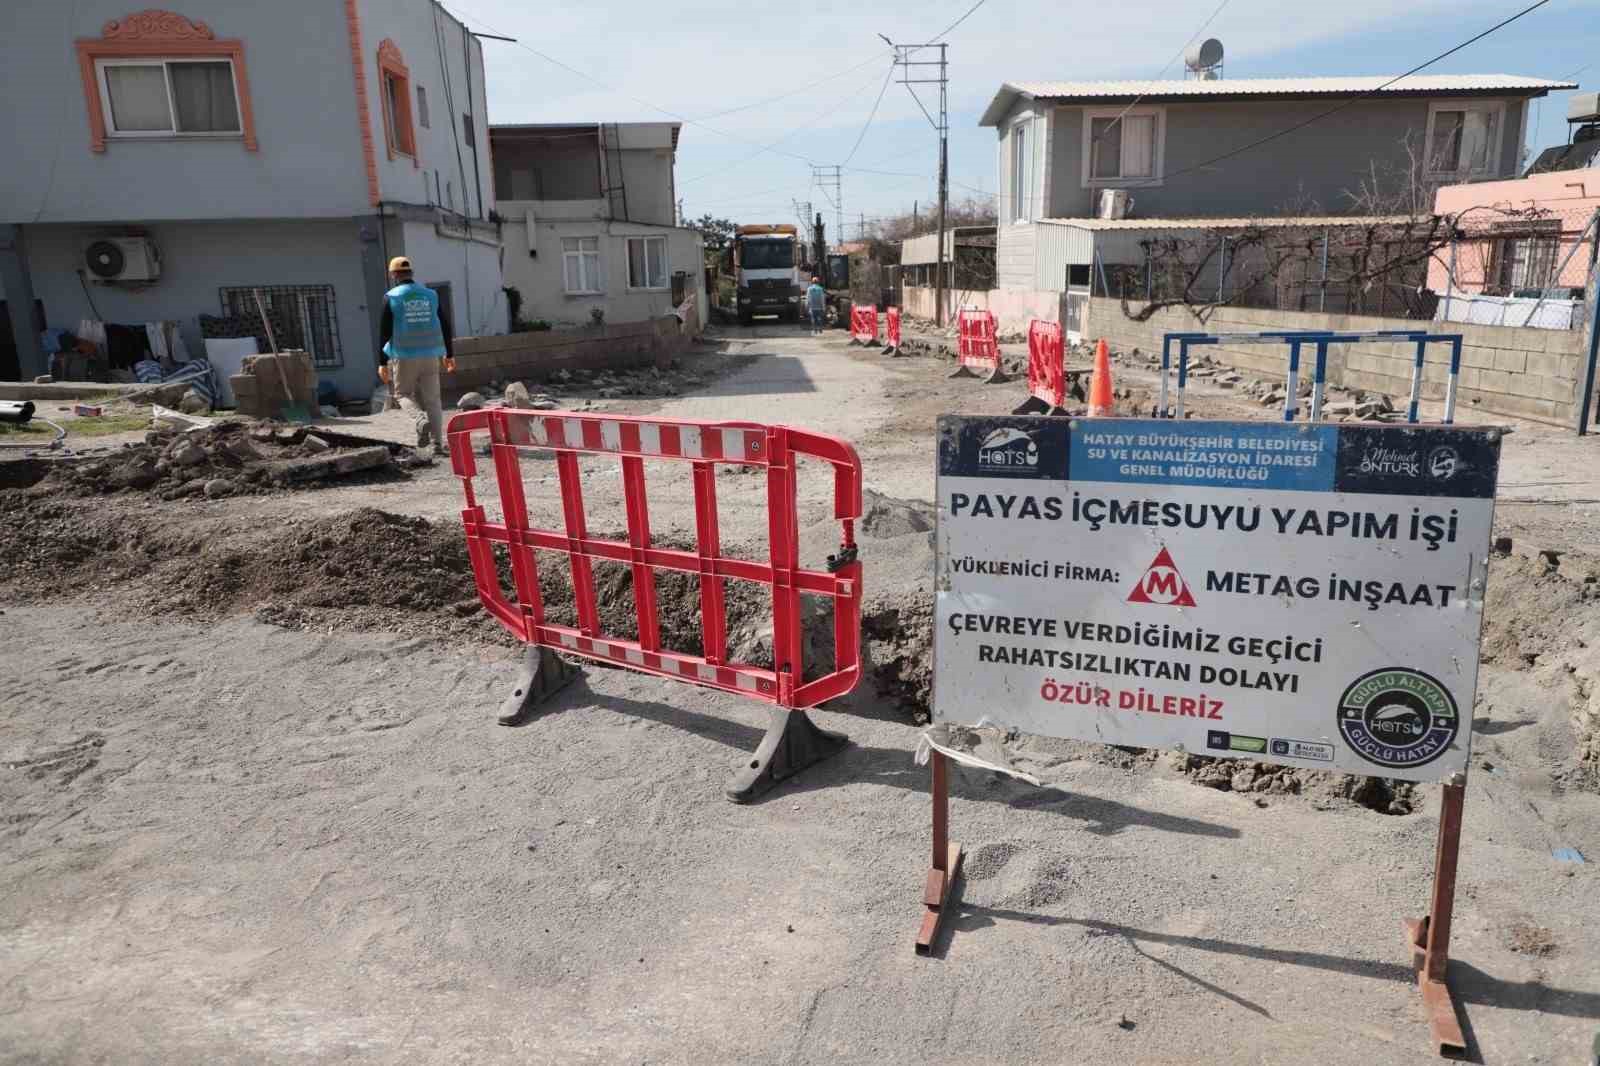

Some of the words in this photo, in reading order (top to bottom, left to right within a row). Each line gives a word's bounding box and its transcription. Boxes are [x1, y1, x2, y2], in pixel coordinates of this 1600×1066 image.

[1083, 433, 1135, 446] HATAY
[1138, 433, 1233, 450] BÜYÜKŞEHİR
[1239, 437, 1324, 452] BELEDİYESİ
[1087, 448, 1106, 459] SU
[1111, 449, 1128, 460] VE
[1132, 449, 1250, 466] KANALİZASYON
[1256, 451, 1317, 467] İDARESİ
[1120, 464, 1166, 477] GENEL
[1169, 463, 1269, 481] MÜDÜRLÜĞÜ
[950, 492, 1063, 520] PAYAS
[1072, 491, 1260, 533] İÇMESUYU
[1271, 507, 1399, 541] YAPIM
[1409, 507, 1458, 551] İŞİ
[952, 556, 1048, 578] YÜKLENİCİ
[1054, 561, 1120, 583] FİRMA:
[1206, 570, 1320, 598] METAG
[1328, 573, 1456, 610] İNŞAAT
[948, 612, 1057, 637] ÇEVREYE
[1064, 620, 1221, 653] VERDİĞİMİZ
[1228, 635, 1323, 664] GEÇİCİ
[978, 644, 1191, 682] RAHATSIZLIKTAN
[1199, 664, 1299, 693] DOLAYI
[1040, 677, 1111, 708] ÖZÜR
[1119, 686, 1225, 721] DİLERİZ
[1396, 736, 1439, 761] HATAY
